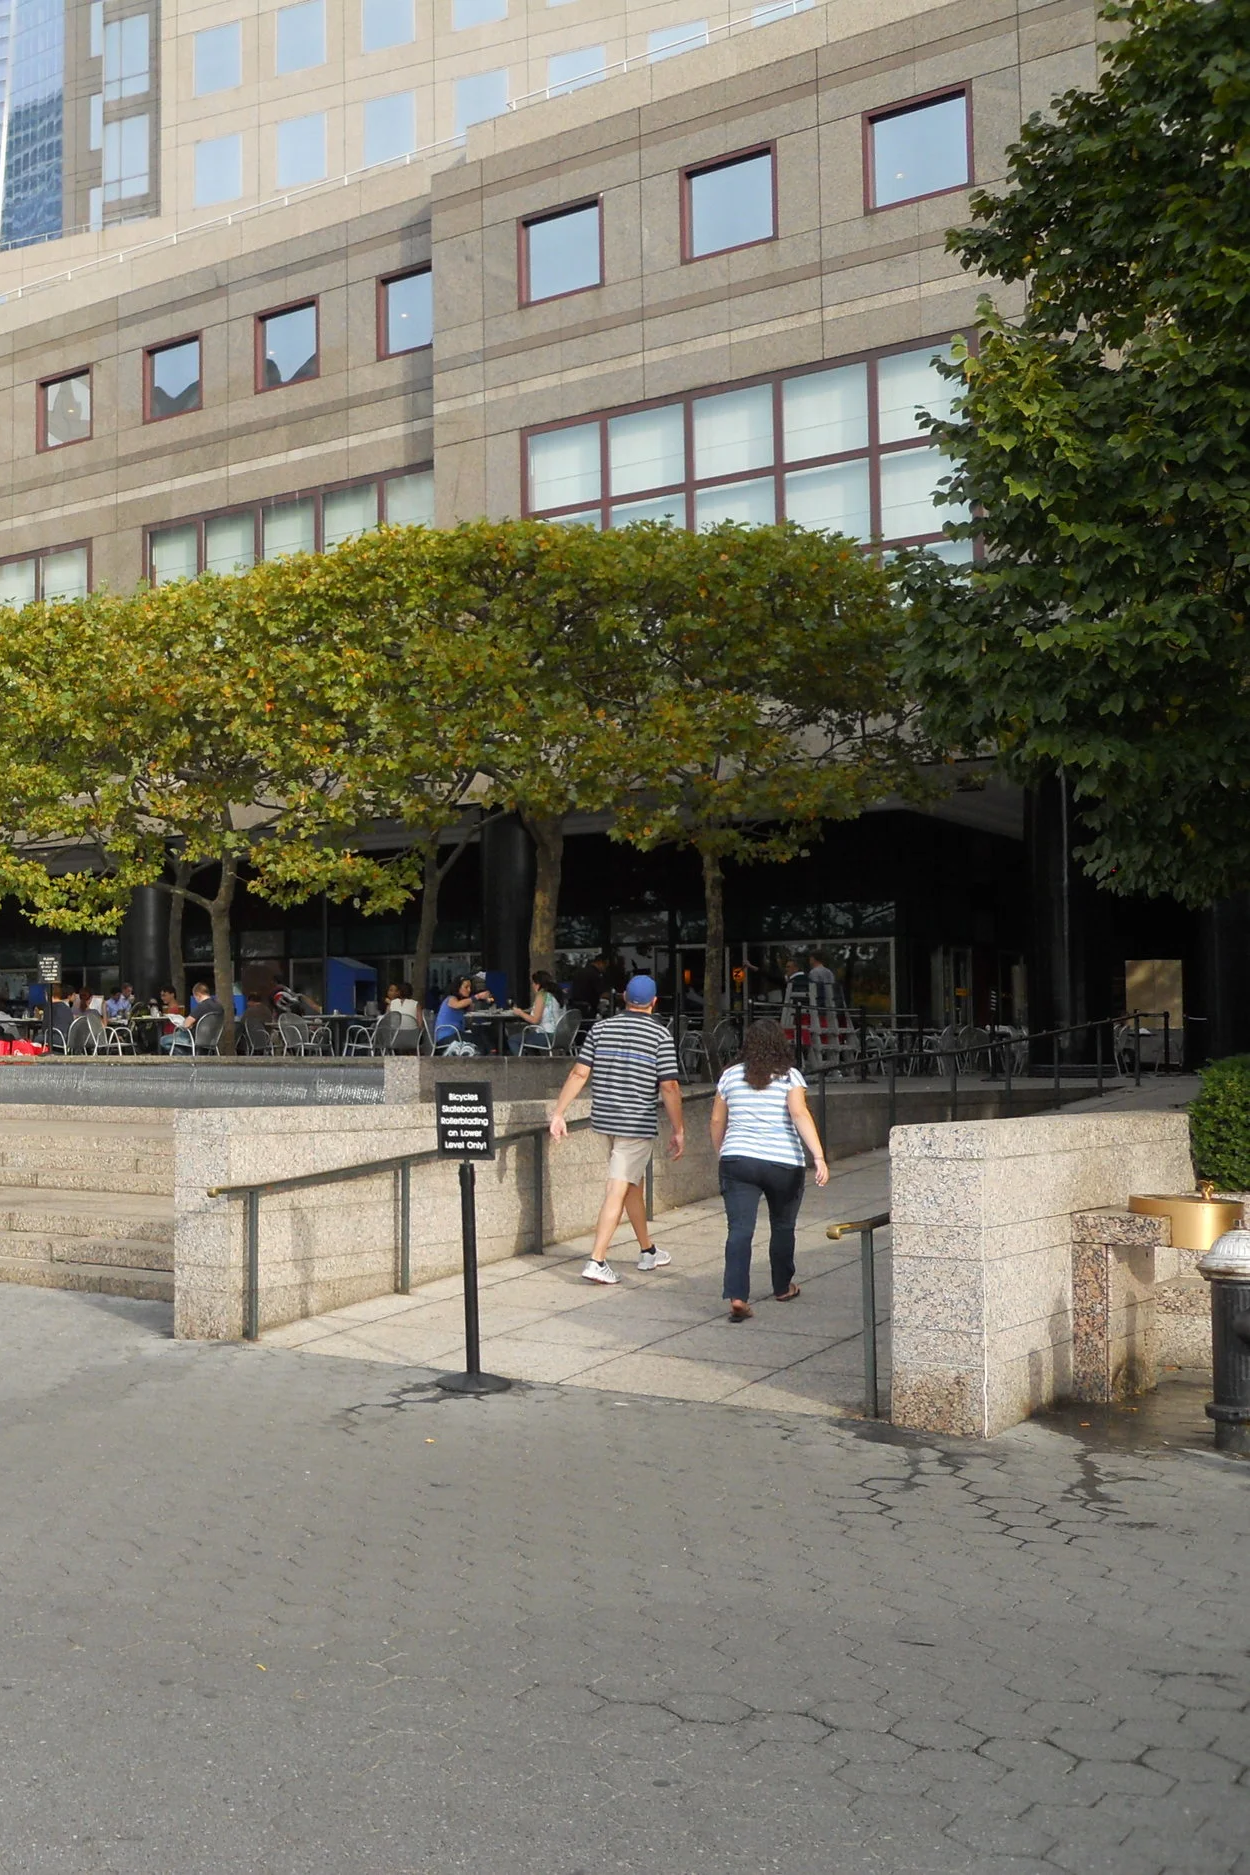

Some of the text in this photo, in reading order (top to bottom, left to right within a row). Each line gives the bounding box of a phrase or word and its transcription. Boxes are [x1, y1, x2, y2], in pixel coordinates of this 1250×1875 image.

[448, 1093, 478, 1102] Bicycles
[441, 1105, 487, 1113] Skateboards
[440, 1117, 489, 1126] Rollerblading
[460, 1129, 483, 1137] Lower
[444, 1141, 487, 1150] Level Only!
